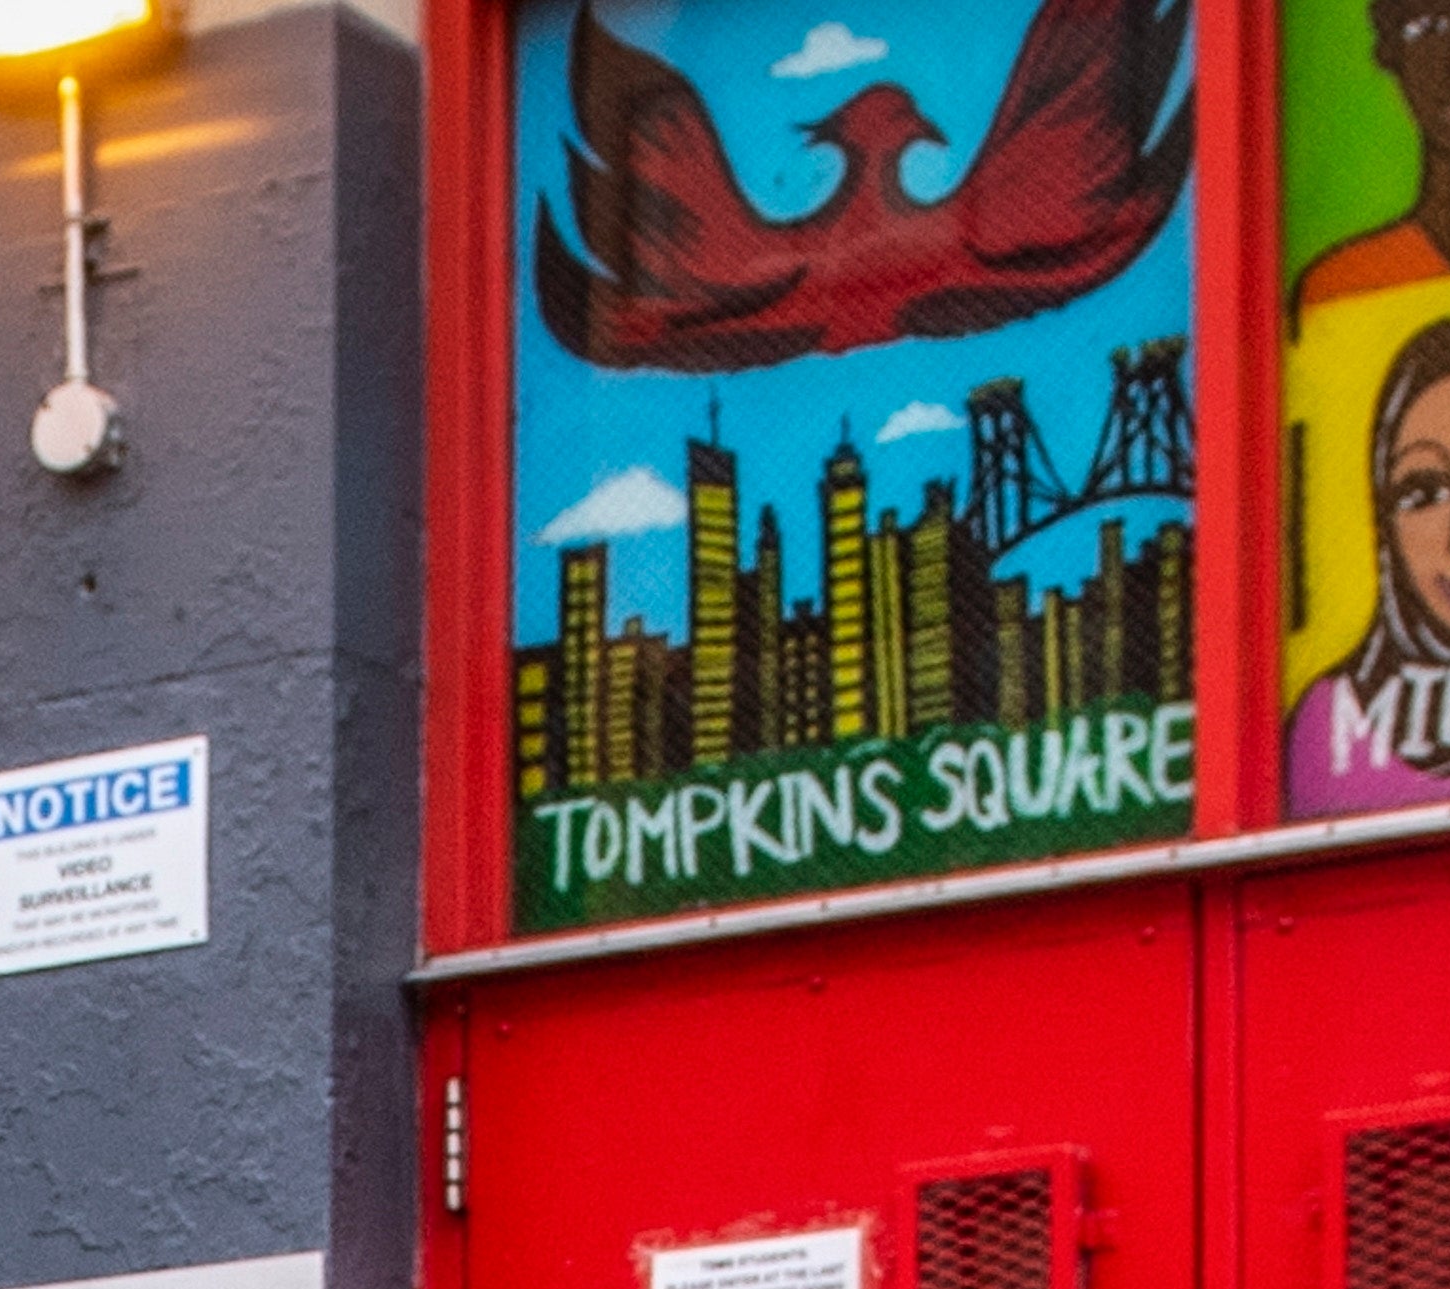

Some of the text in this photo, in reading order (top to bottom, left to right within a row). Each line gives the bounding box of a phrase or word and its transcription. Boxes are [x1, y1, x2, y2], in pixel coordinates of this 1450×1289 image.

[535, 703, 1195, 893] TOMPKINS SQUARE
[57, 855, 113, 879] VIDEO
[19, 873, 152, 911] SURVEILLANCE
